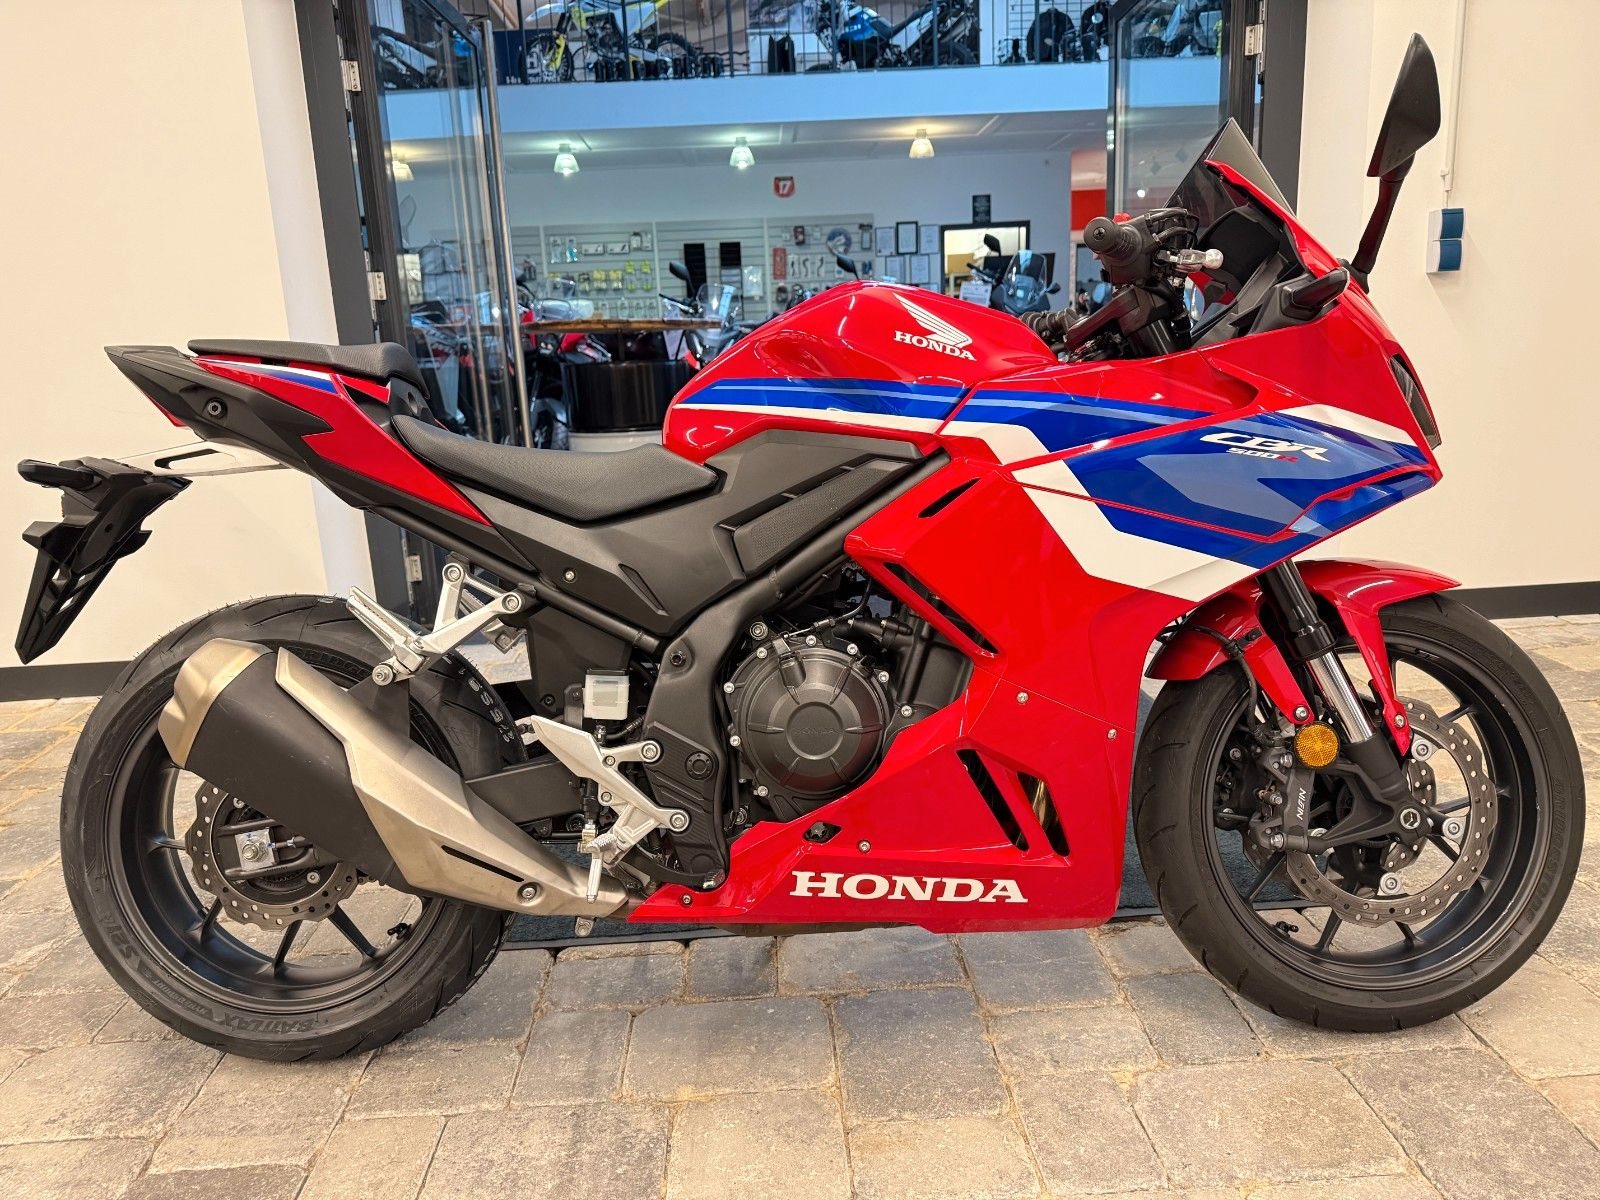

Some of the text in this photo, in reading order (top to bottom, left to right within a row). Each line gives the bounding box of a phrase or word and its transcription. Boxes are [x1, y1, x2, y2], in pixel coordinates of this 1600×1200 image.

[893, 329, 977, 361] HONDA
[1199, 432, 1332, 462] CBR
[1226, 447, 1298, 463] 500R
[789, 870, 1029, 903] HONDA
